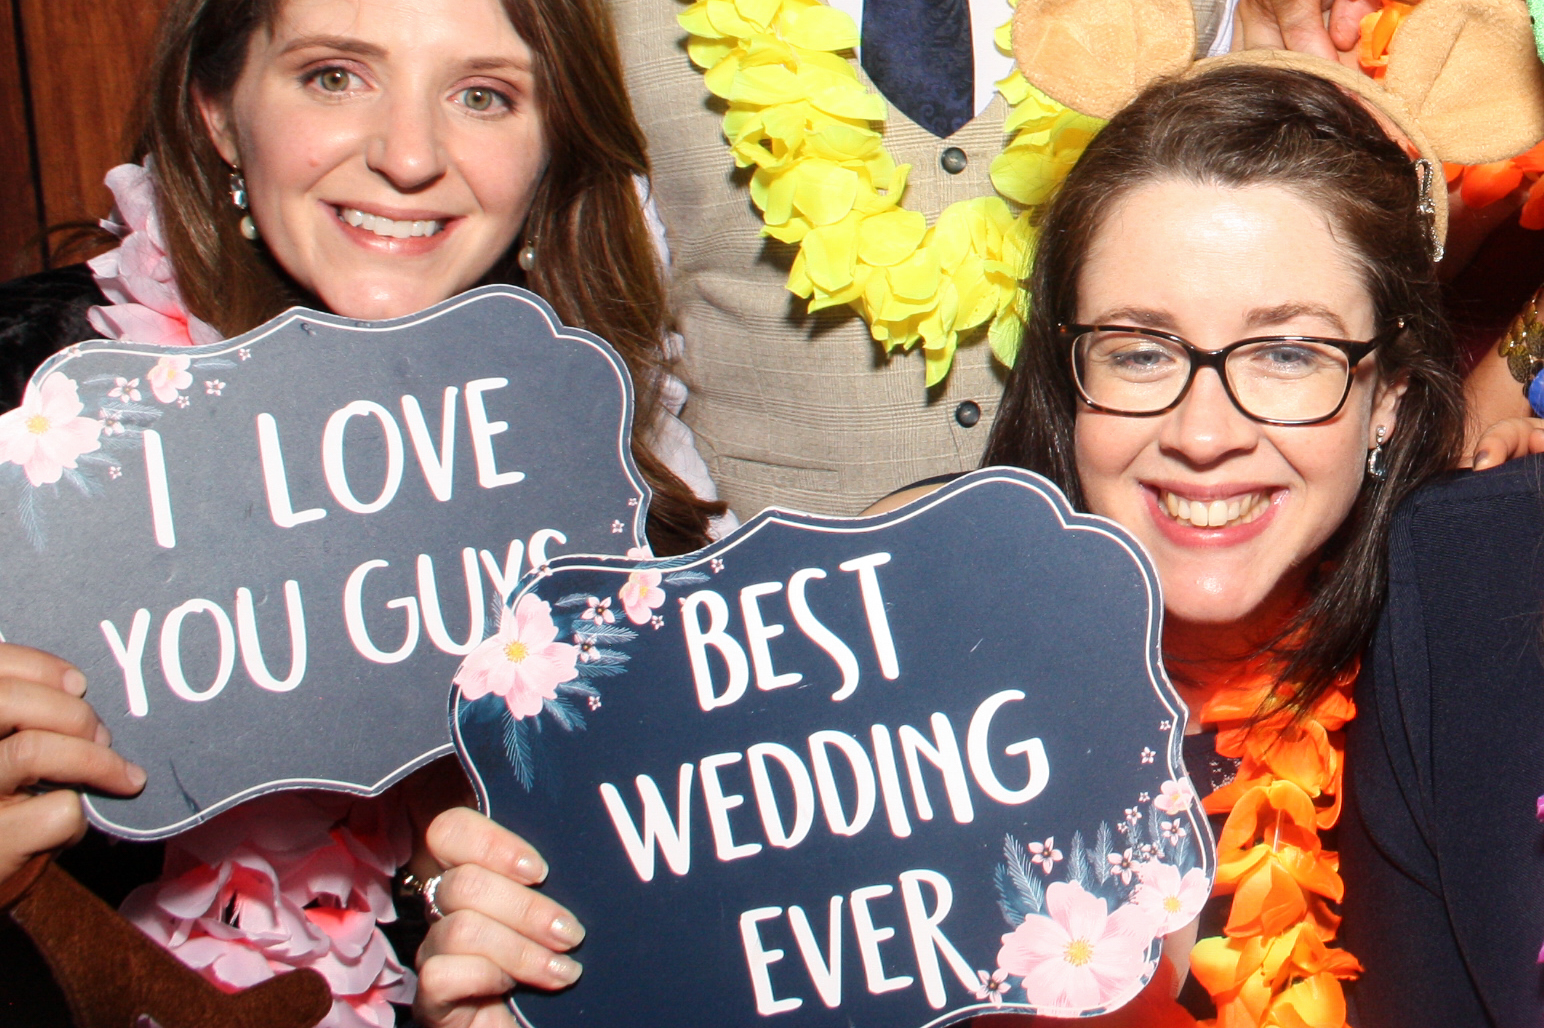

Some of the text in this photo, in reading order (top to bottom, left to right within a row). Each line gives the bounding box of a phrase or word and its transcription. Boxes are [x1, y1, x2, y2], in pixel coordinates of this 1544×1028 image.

[143, 377, 525, 549] I LOVE
[101, 579, 307, 717] YOU
[681, 552, 900, 712] BEST
[600, 689, 1050, 883] WEDDING
[740, 869, 979, 1015] EVER
